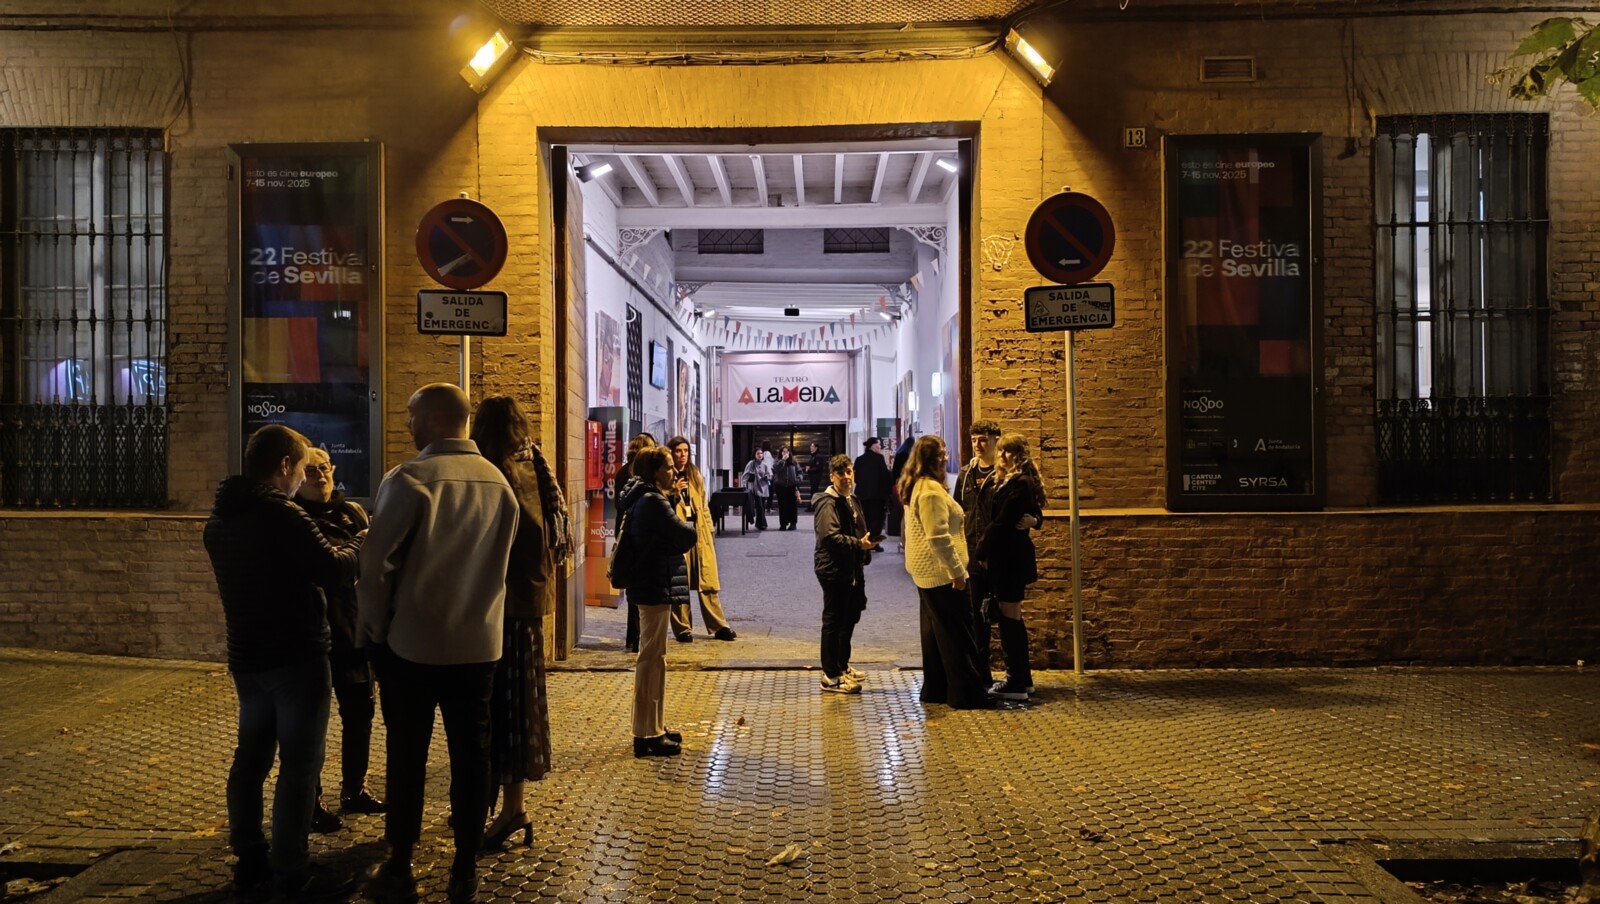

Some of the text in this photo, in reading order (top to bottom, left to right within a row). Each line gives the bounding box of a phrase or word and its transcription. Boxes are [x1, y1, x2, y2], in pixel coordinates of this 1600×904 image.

[1128, 129, 1143, 145] 13
[1234, 161, 1275, 170] europeo
[279, 169, 298, 177] cine
[300, 170, 338, 180] europeo
[1181, 170, 1200, 179] 7-15
[1222, 170, 1246, 179] 2025
[246, 179, 265, 187] 7-15
[287, 179, 310, 188] 2025
[1183, 240, 1213, 258] 22
[249, 247, 277, 265] 22
[1222, 258, 1300, 277] Sevilla
[283, 266, 363, 284] Sevilla
[442, 296, 484, 306] SALIDA
[1048, 290, 1090, 301] SALIDA
[455, 308, 470, 317] DE
[1062, 303, 1077, 312] DE
[424, 319, 490, 329] EMERGENC
[1031, 313, 1108, 326] EMERGENCIA
[604, 419, 617, 499] de Sevilla
[1239, 477, 1288, 487] SYRSA
